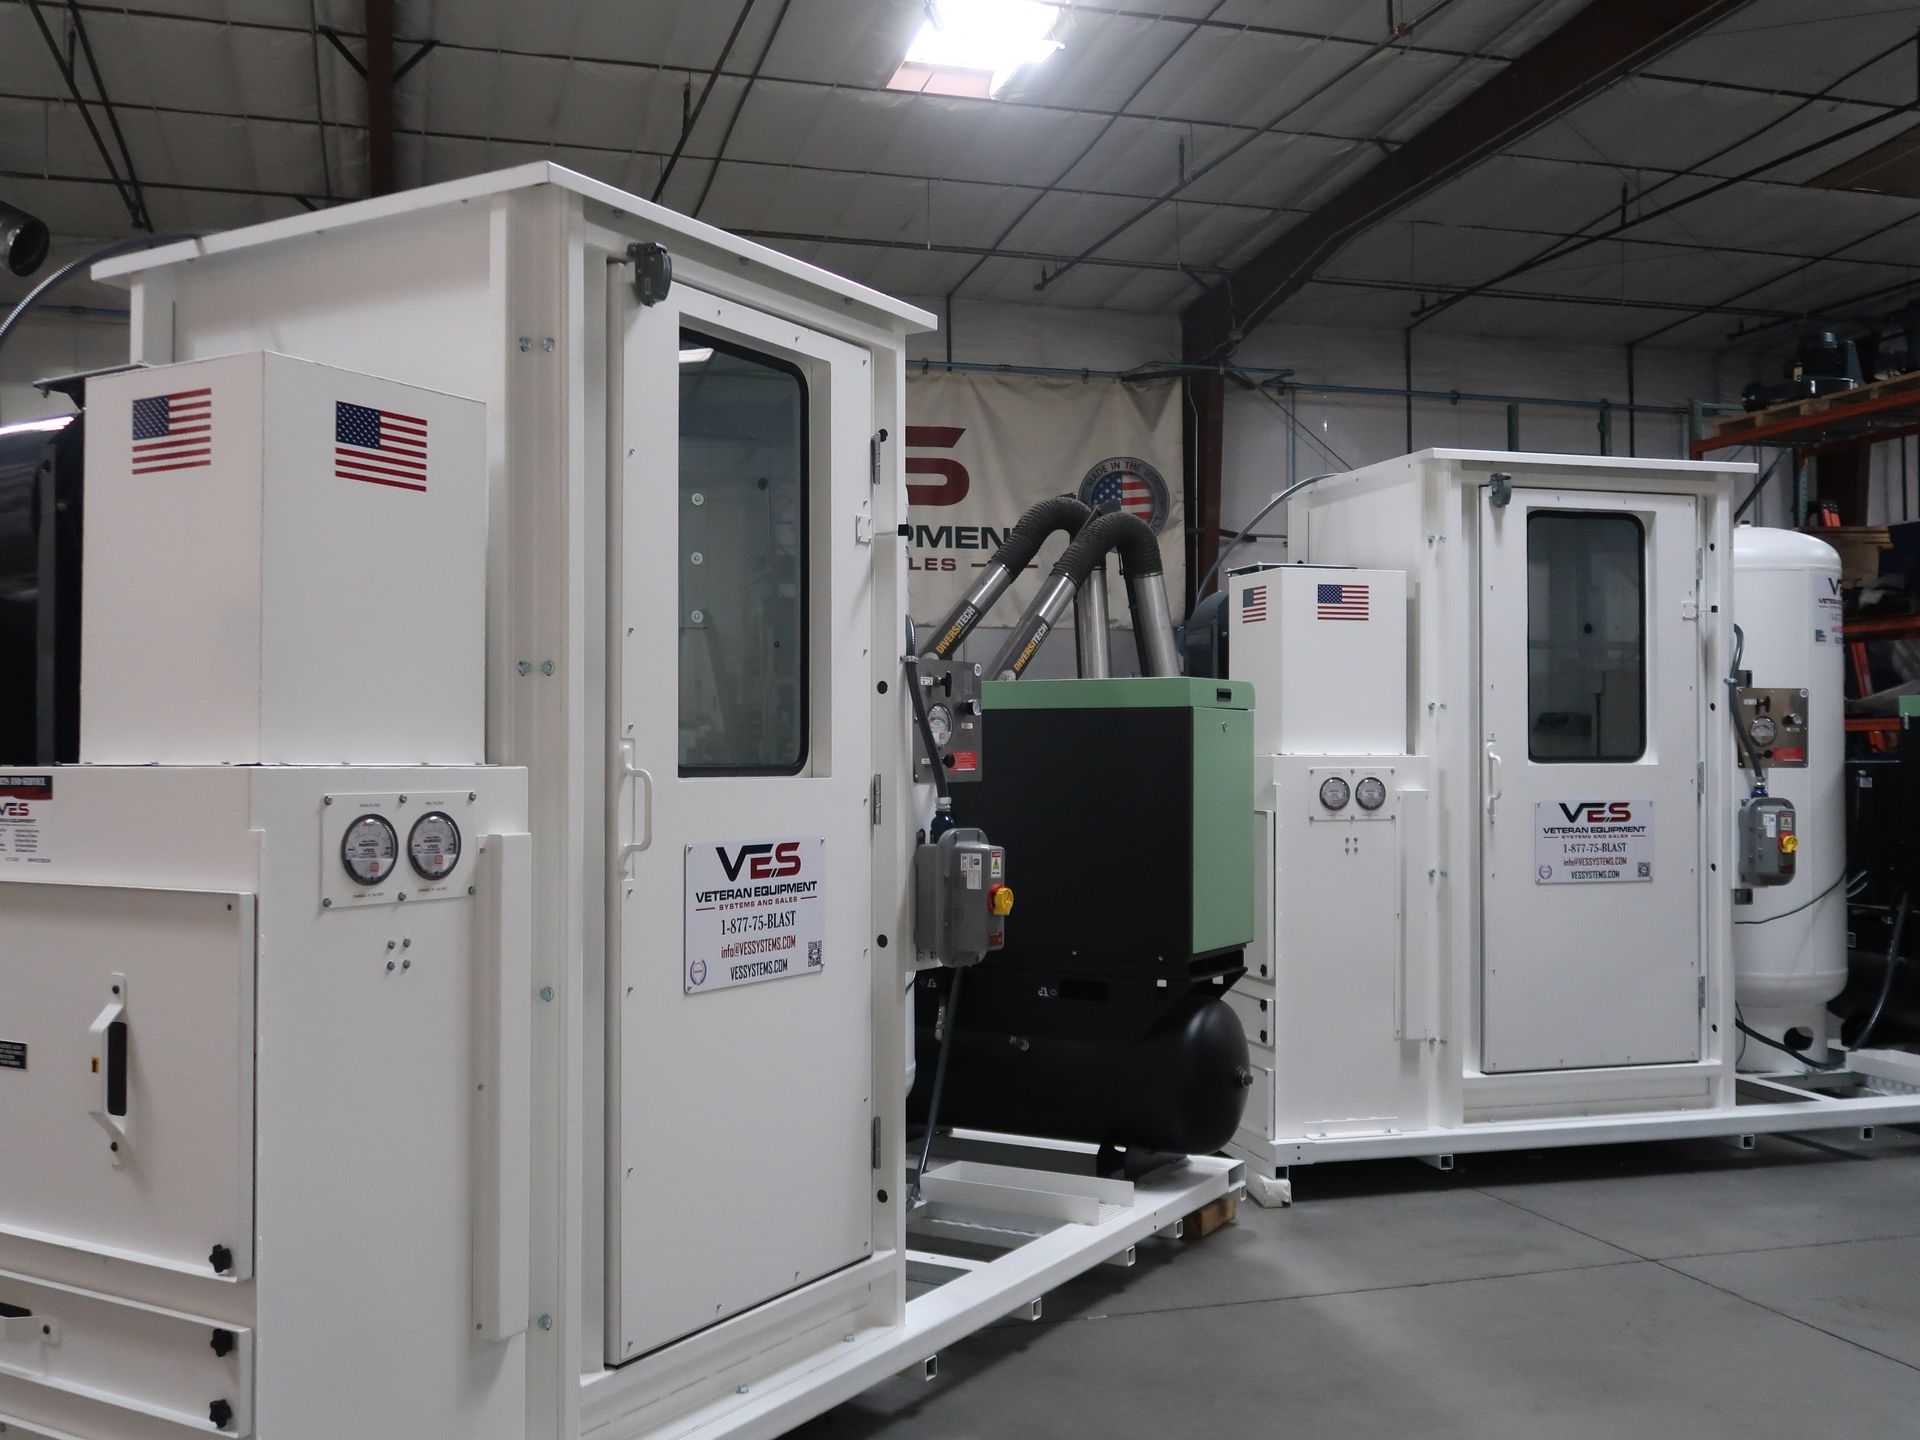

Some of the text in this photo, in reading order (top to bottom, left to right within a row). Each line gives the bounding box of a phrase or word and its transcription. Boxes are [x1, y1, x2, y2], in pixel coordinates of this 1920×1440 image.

[1111, 462, 1121, 471] IN
[1125, 461, 1143, 473] THE
[908, 525, 1012, 549] MEN
[935, 605, 976, 655] DIVERSITECH
[1013, 622, 1050, 672] DIVERSITECH
[1558, 802, 1632, 823] VES
[1543, 826, 1646, 835] VETERAN EQUIPMENT
[1563, 843, 1627, 853] 1-877-75-BLAST
[715, 841, 801, 882] VES
[1571, 870, 1620, 879] VESSYSTEMS.COM
[695, 881, 818, 903] VETERAN EQUIPMENT
[719, 896, 798, 911] SYSTEMS AND SALES
[721, 910, 796, 936] 1-877-75-BLAST
[721, 935, 796, 959] info@VESSYSTEMS.COM
[730, 958, 788, 980] VESSYSTEMS.COM
